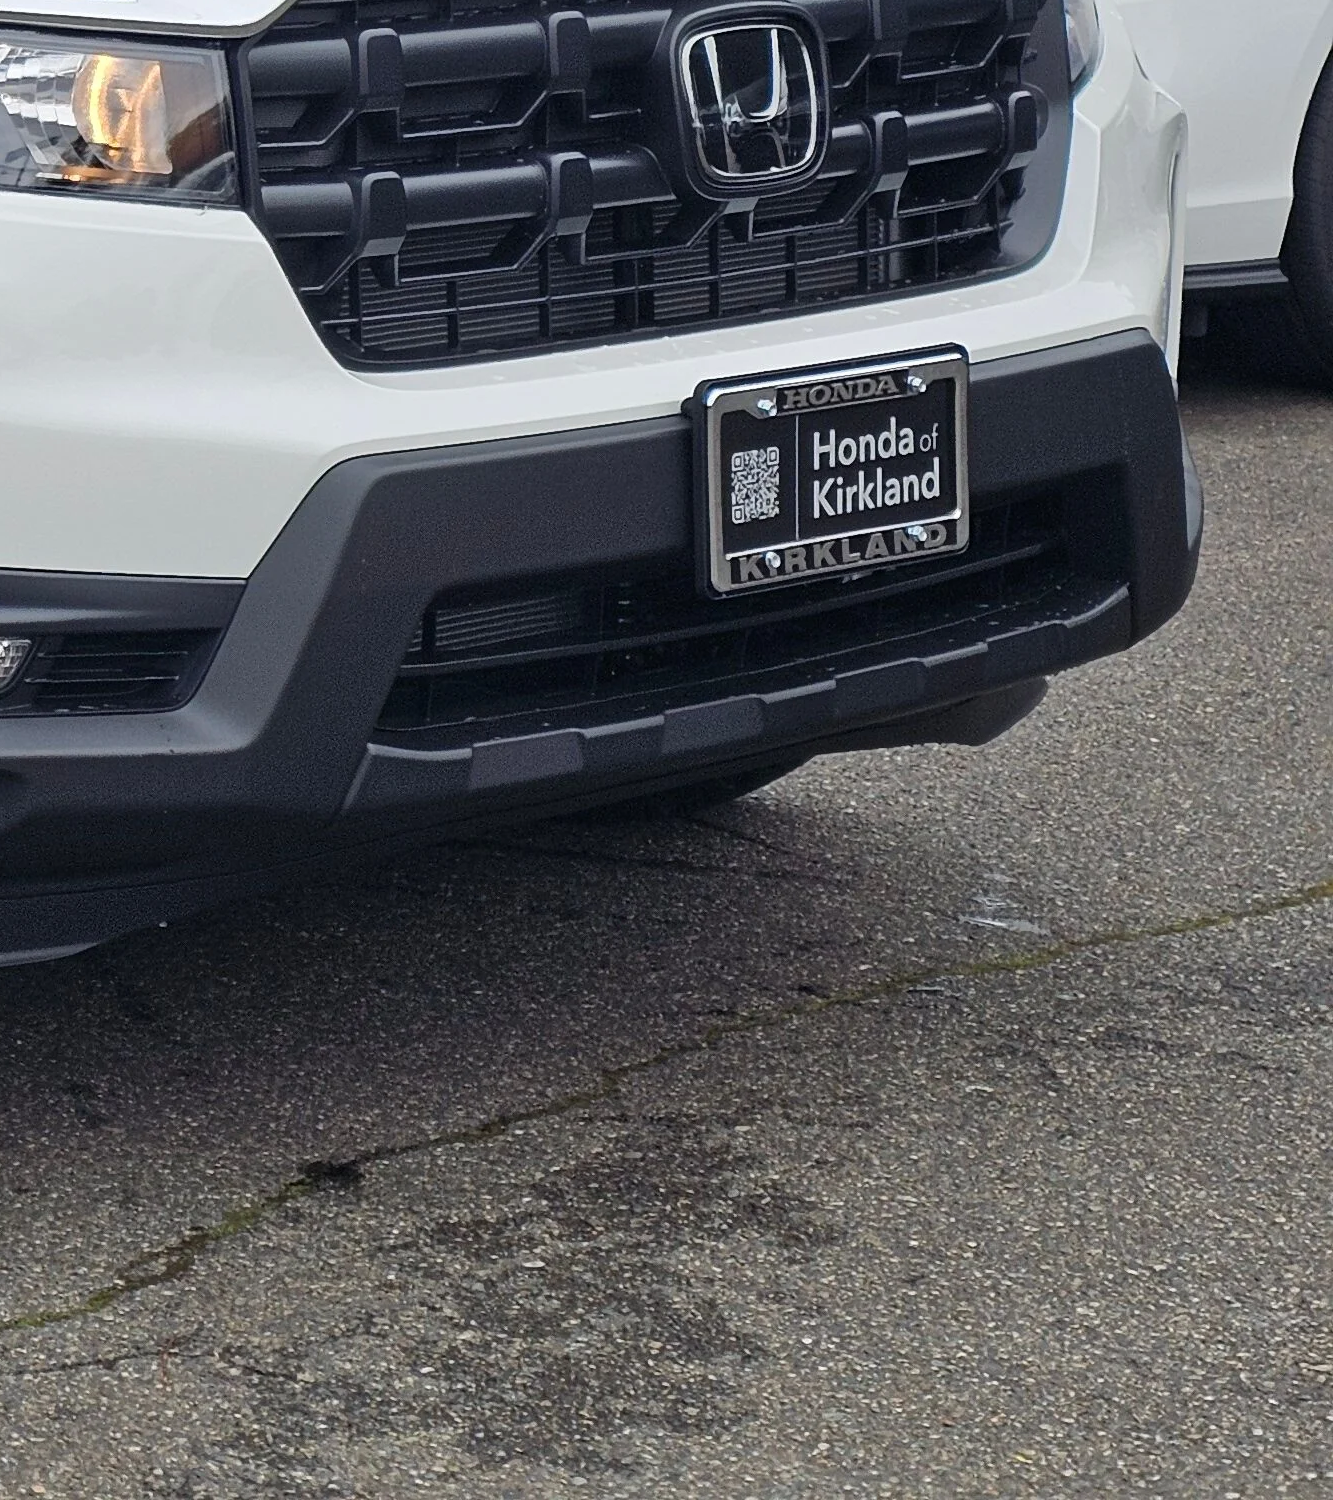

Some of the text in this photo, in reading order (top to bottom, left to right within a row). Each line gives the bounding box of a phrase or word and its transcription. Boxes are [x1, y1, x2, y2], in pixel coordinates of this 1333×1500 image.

[783, 374, 900, 409] HONDA
[813, 416, 939, 471] Honda of
[813, 456, 940, 519] Kirkland
